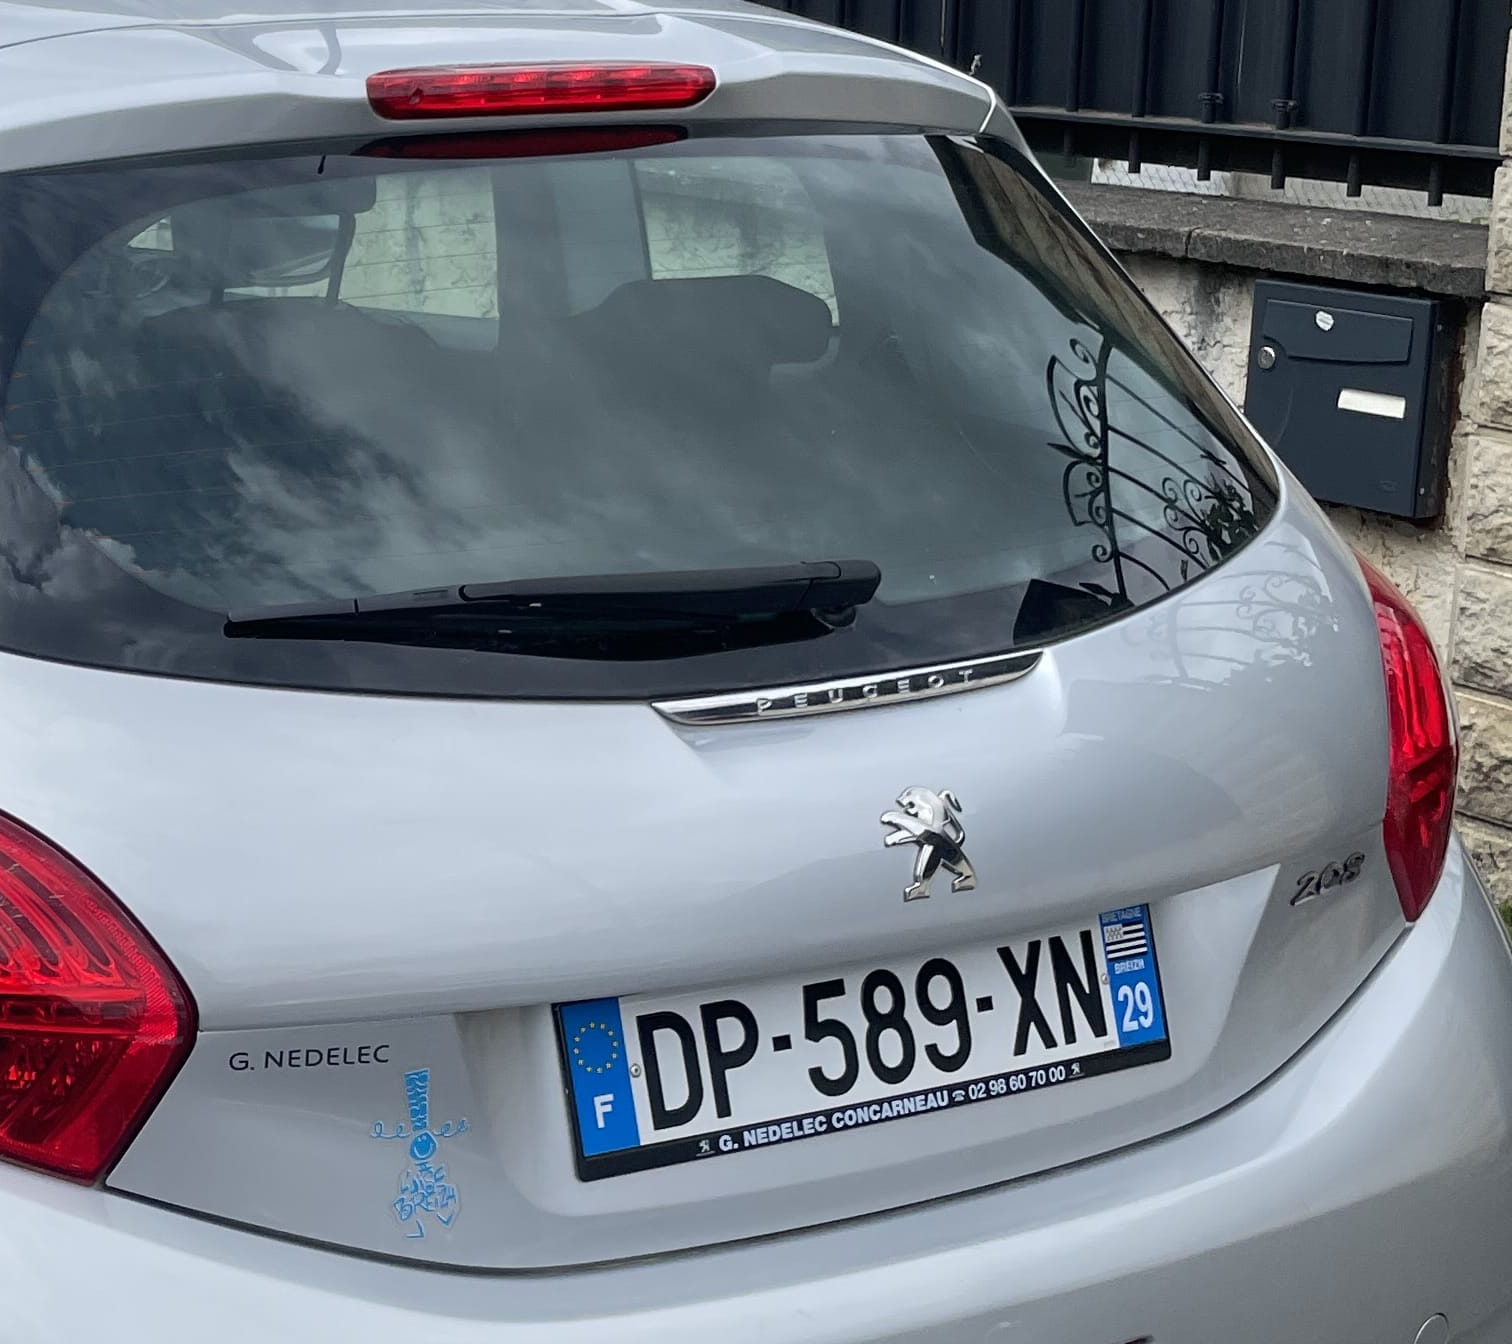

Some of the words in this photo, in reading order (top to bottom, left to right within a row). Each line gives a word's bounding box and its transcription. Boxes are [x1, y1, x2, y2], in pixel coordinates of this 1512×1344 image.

[756, 668, 973, 715] PEUGEOT
[1290, 851, 1365, 906] 208
[635, 928, 1108, 1131] DP-589-XN
[1117, 981, 1154, 1033] 29
[229, 1052, 255, 1072] G.
[264, 1044, 391, 1070] NEDELEC
[593, 1094, 614, 1130] F
[718, 1134, 739, 1152] G.
[743, 1115, 828, 1147] NEDELEC
[831, 1089, 949, 1129] CONCARNEAU
[968, 1082, 987, 1100] 02
[989, 1078, 1007, 1096] 98
[1009, 1073, 1027, 1091] 60
[1029, 1069, 1047, 1087] 70
[1048, 1065, 1066, 1083] 00
